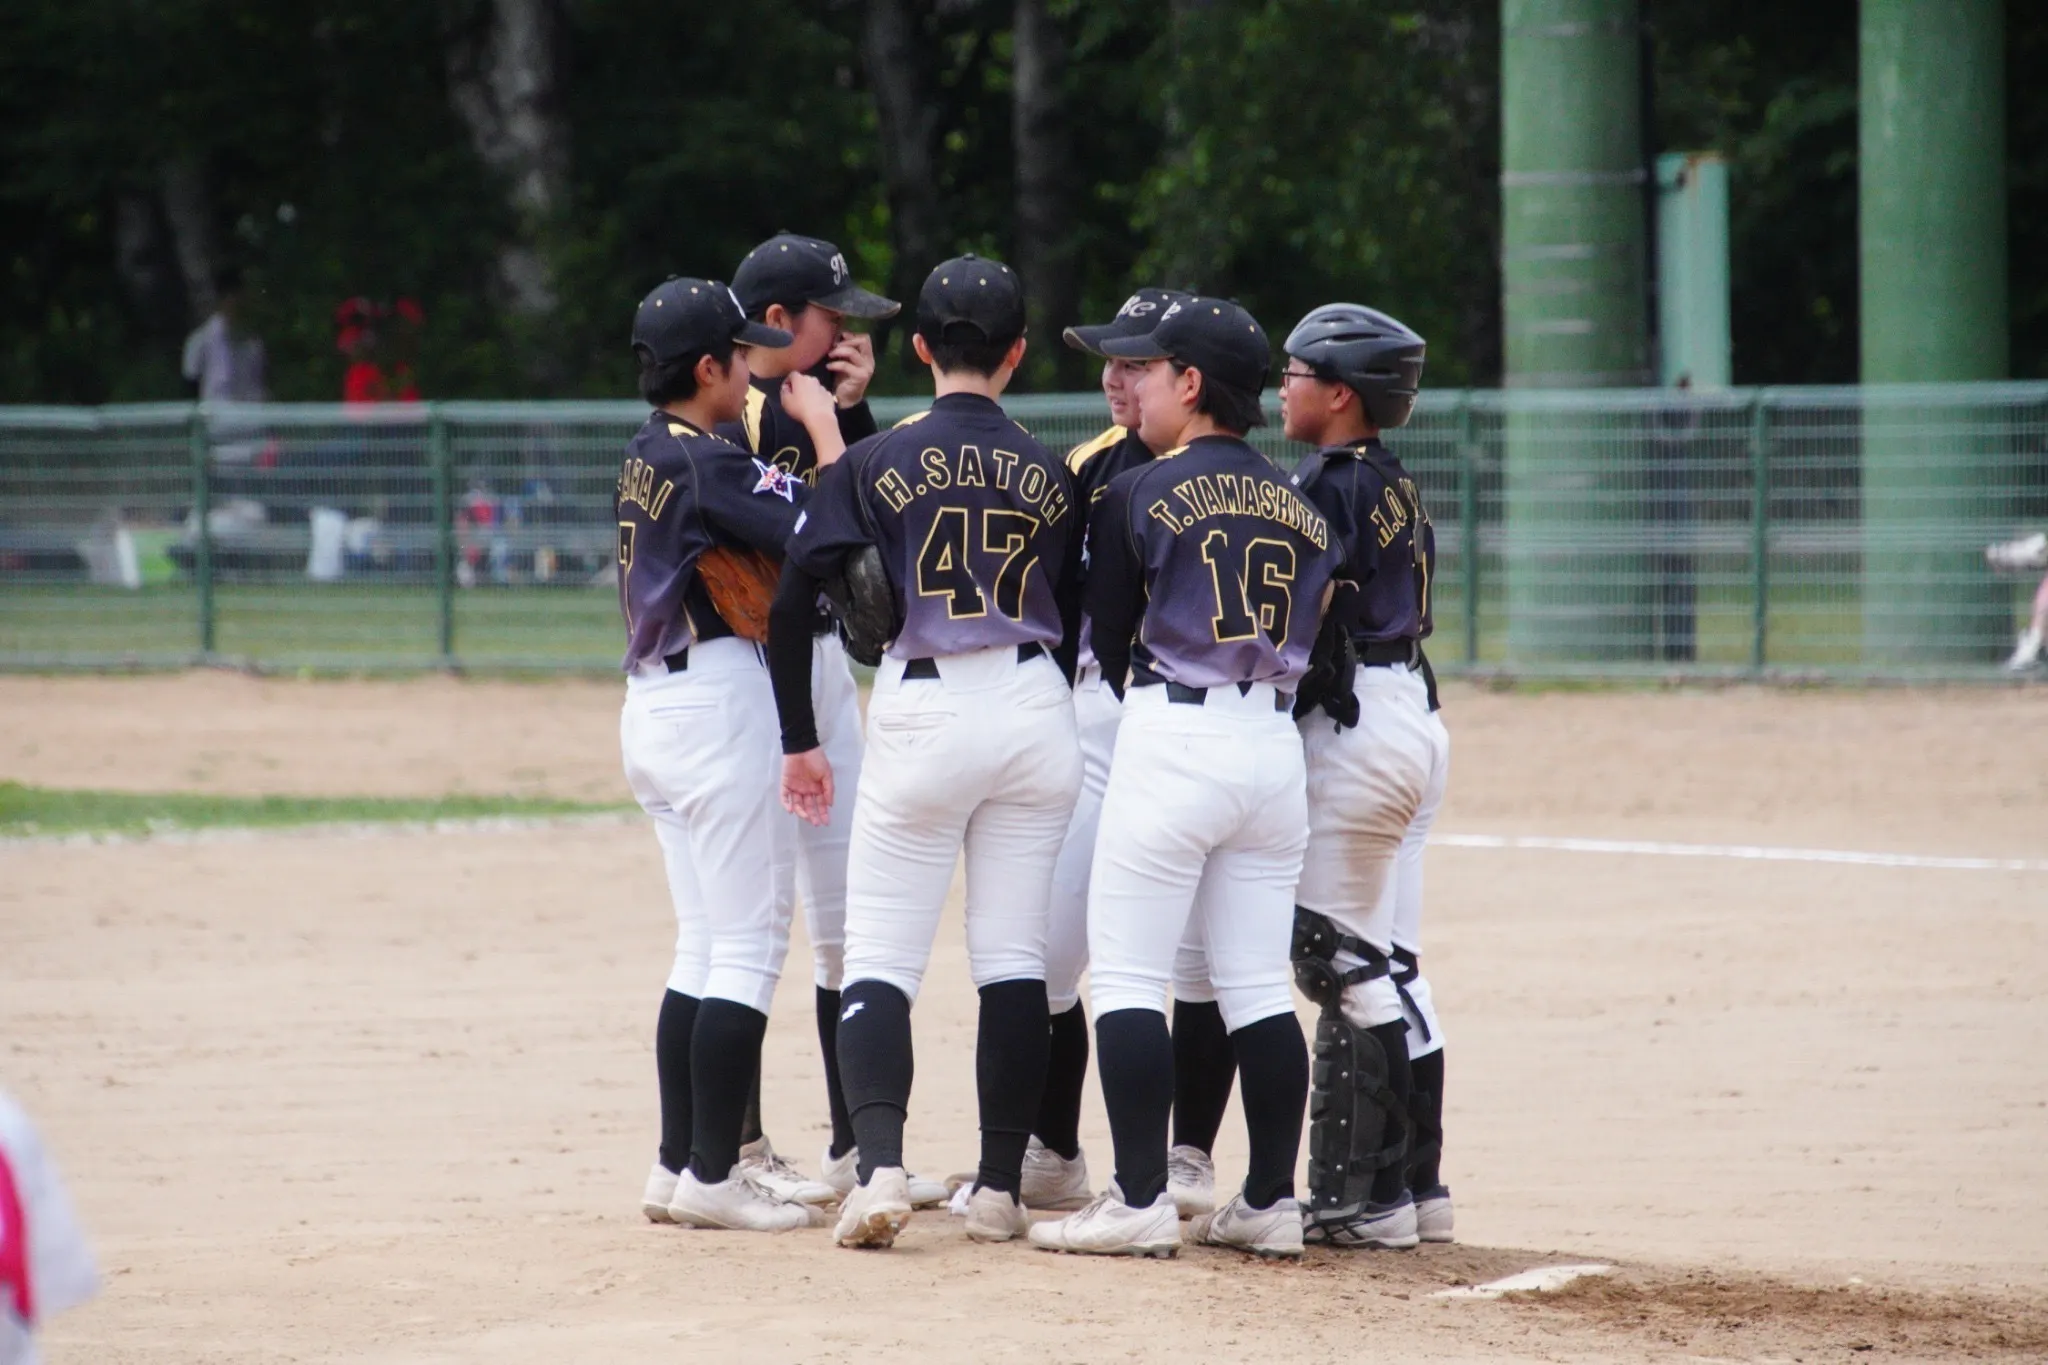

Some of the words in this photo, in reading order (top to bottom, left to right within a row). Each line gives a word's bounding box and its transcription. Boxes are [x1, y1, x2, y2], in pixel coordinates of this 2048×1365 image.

[875, 444, 1068, 527] H.SATOH
[1148, 473, 1328, 551] T.YAMASHITA
[916, 506, 1040, 622] 47
[1201, 529, 1296, 652] 16
